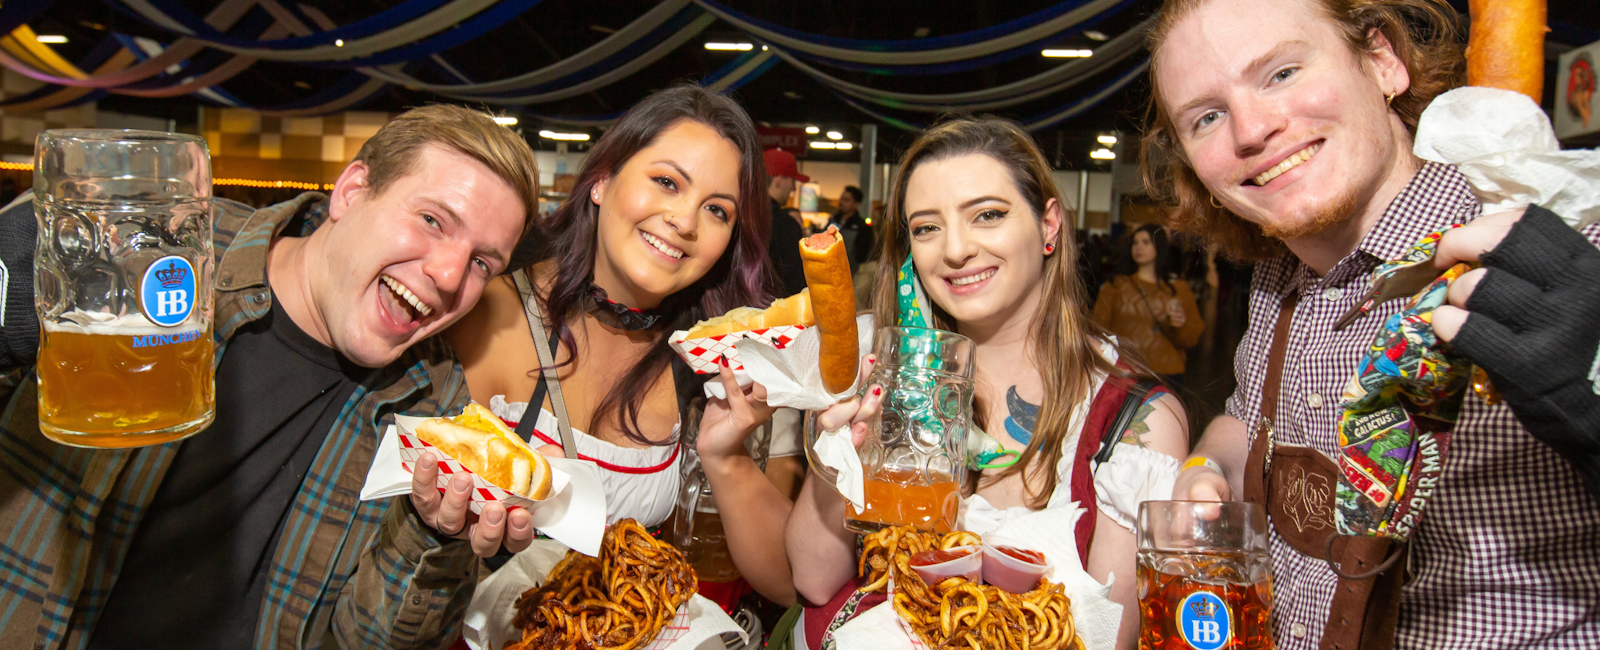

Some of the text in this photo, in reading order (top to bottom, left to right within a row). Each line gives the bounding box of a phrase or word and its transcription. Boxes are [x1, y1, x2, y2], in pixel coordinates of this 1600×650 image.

[156, 289, 188, 317] HB
[132, 329, 202, 348] MÜNCHEN
[1355, 416, 1369, 427] AND
[1368, 489, 1385, 502] OF
[1191, 619, 1221, 643] HB
